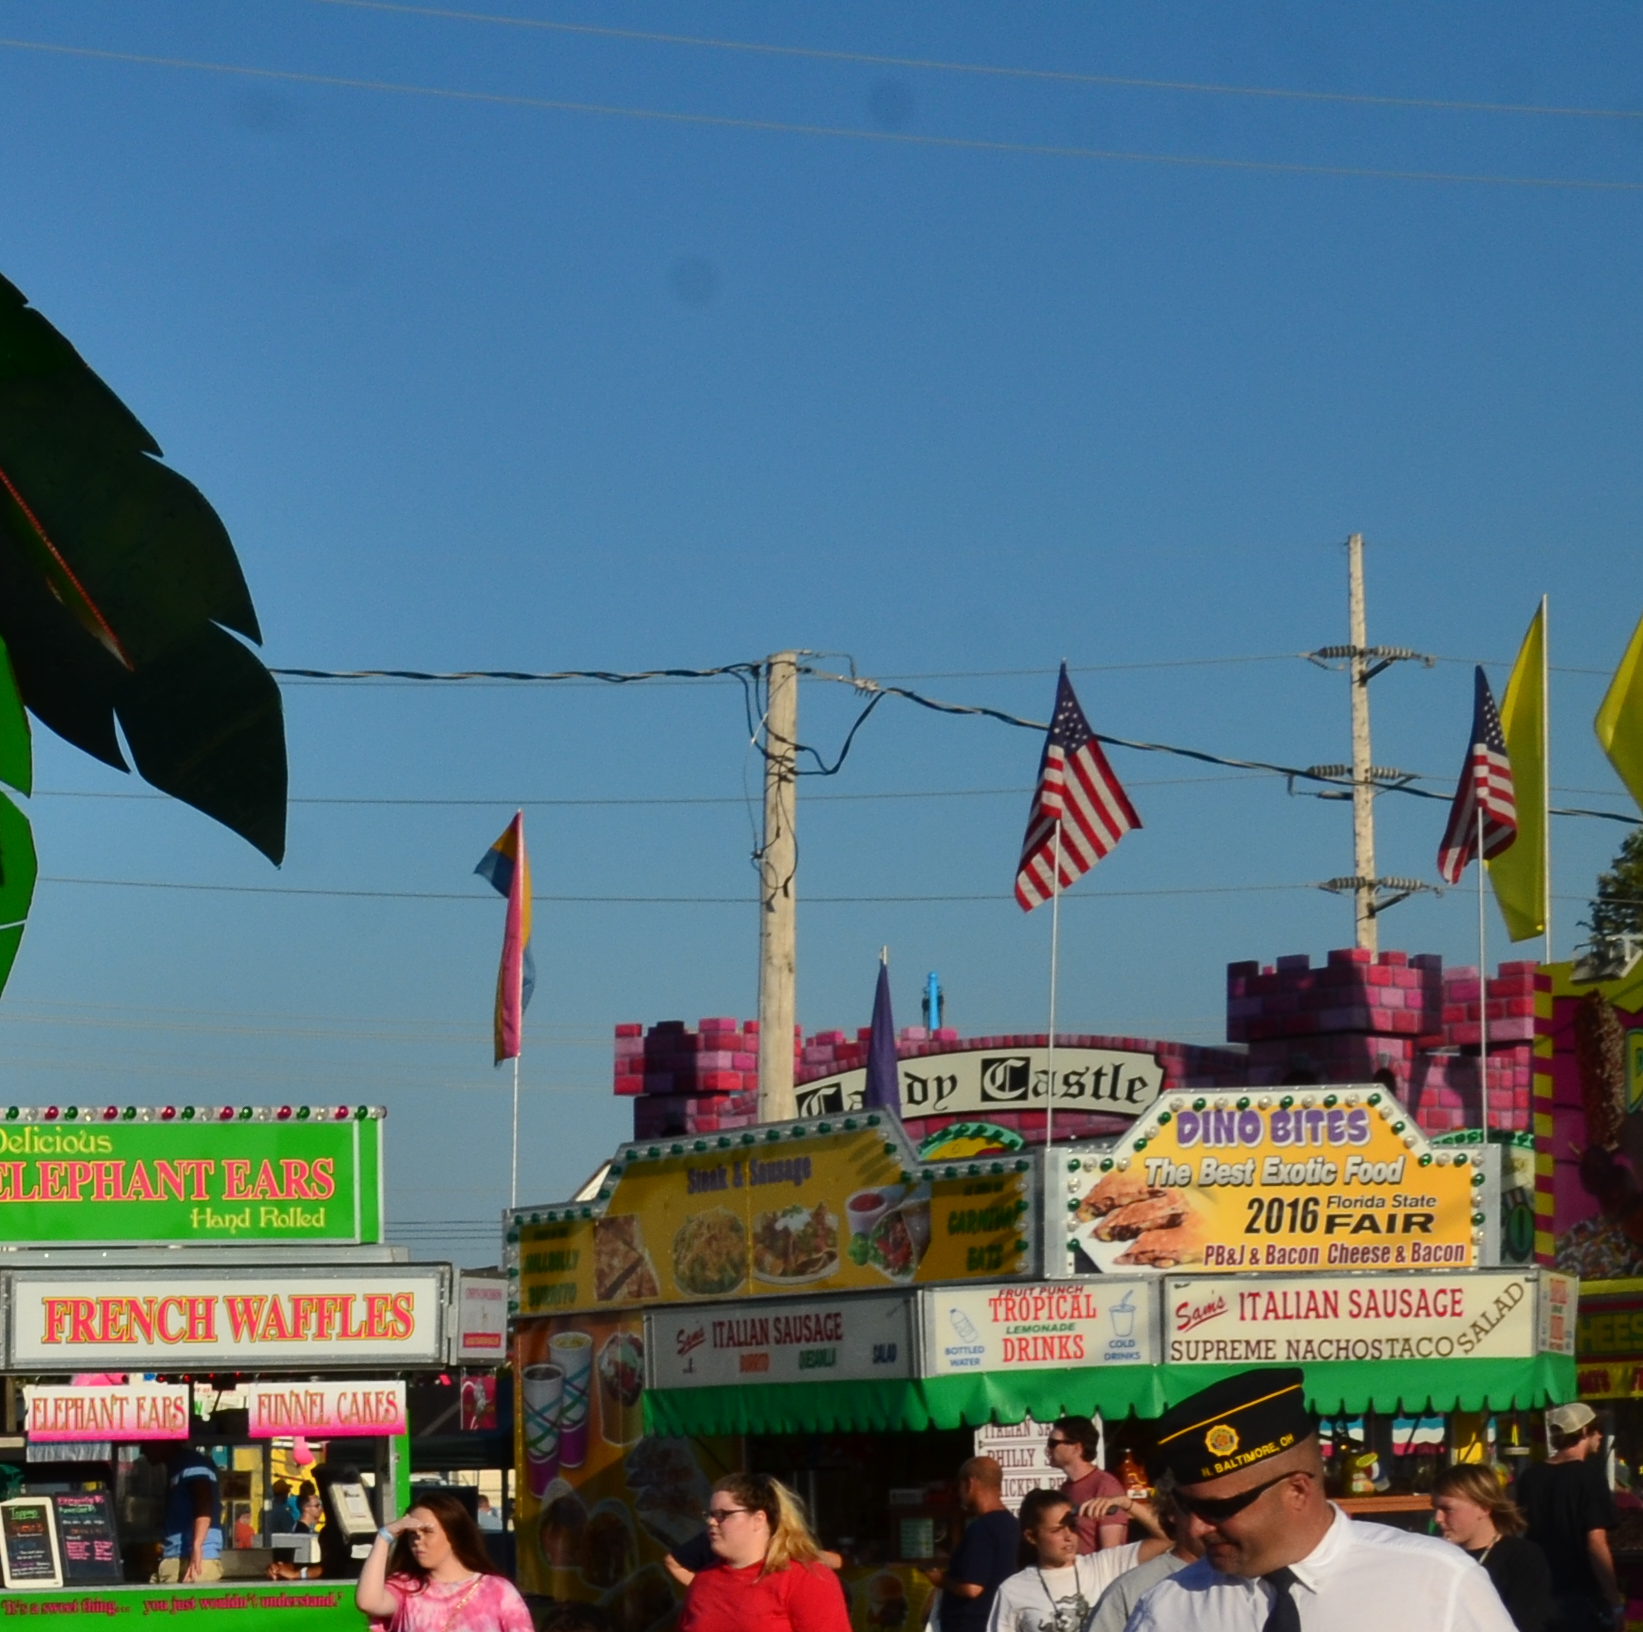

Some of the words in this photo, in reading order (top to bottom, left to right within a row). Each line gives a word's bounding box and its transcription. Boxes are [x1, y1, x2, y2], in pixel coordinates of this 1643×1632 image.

[981, 1056, 1149, 1104] Castle
[1176, 1109, 1264, 1148] DINO
[1270, 1107, 1370, 1147] BITES
[221, 1157, 336, 1201] EARS
[749, 1156, 812, 1187] Sausage
[1145, 1158, 1192, 1187] The
[1198, 1157, 1255, 1187] Best
[1261, 1157, 1338, 1186] Exotic
[1344, 1155, 1405, 1185] Food
[189, 1207, 251, 1233] Hand
[259, 1207, 326, 1228] Rolled
[1244, 1196, 1321, 1235] 2016
[1326, 1195, 1388, 1210] Florida
[1391, 1194, 1437, 1208] State
[1324, 1213, 1437, 1235] FAIR
[1203, 1246, 1246, 1266] PB&J
[1249, 1248, 1260, 1265] &
[1265, 1245, 1319, 1265] Bacon
[1327, 1243, 1391, 1265] Cheese
[1395, 1245, 1406, 1263] &
[1410, 1242, 1465, 1263] Bacon
[998, 1287, 1035, 1298] FRUIT
[1039, 1285, 1084, 1296] PUNCH
[41, 1296, 218, 1344] FRENCH
[224, 1293, 415, 1343] WAFFLES
[989, 1294, 1097, 1322] TROPICAL
[1171, 1339, 1276, 1362] SUPREME
[1285, 1338, 1383, 1361] NACHOS
[1384, 1336, 1454, 1359] TACO
[1457, 1281, 1525, 1355] SALAD
[1176, 1290, 1228, 1332] Sam's
[1238, 1290, 1341, 1322] ITALIAN
[1348, 1287, 1464, 1319] SAUSAGE
[712, 1318, 770, 1348] ITALIAN
[773, 1312, 843, 1344] SAUSAGE
[1006, 1322, 1076, 1334] LEMONADE
[945, 1345, 985, 1355] BOTTLED
[1002, 1335, 1085, 1362] DRINKS
[1104, 1352, 1141, 1361] DRINKS
[1109, 1340, 1136, 1349] COLD
[950, 1357, 980, 1366] WATER
[31, 1394, 129, 1432] ELEPHANT
[136, 1393, 186, 1431] EARS
[257, 1389, 331, 1427] FUNNEL
[336, 1389, 399, 1425] CAKES
[1214, 1442, 1280, 1473] BALTIMORE,
[1279, 1433, 1294, 1447] OH
